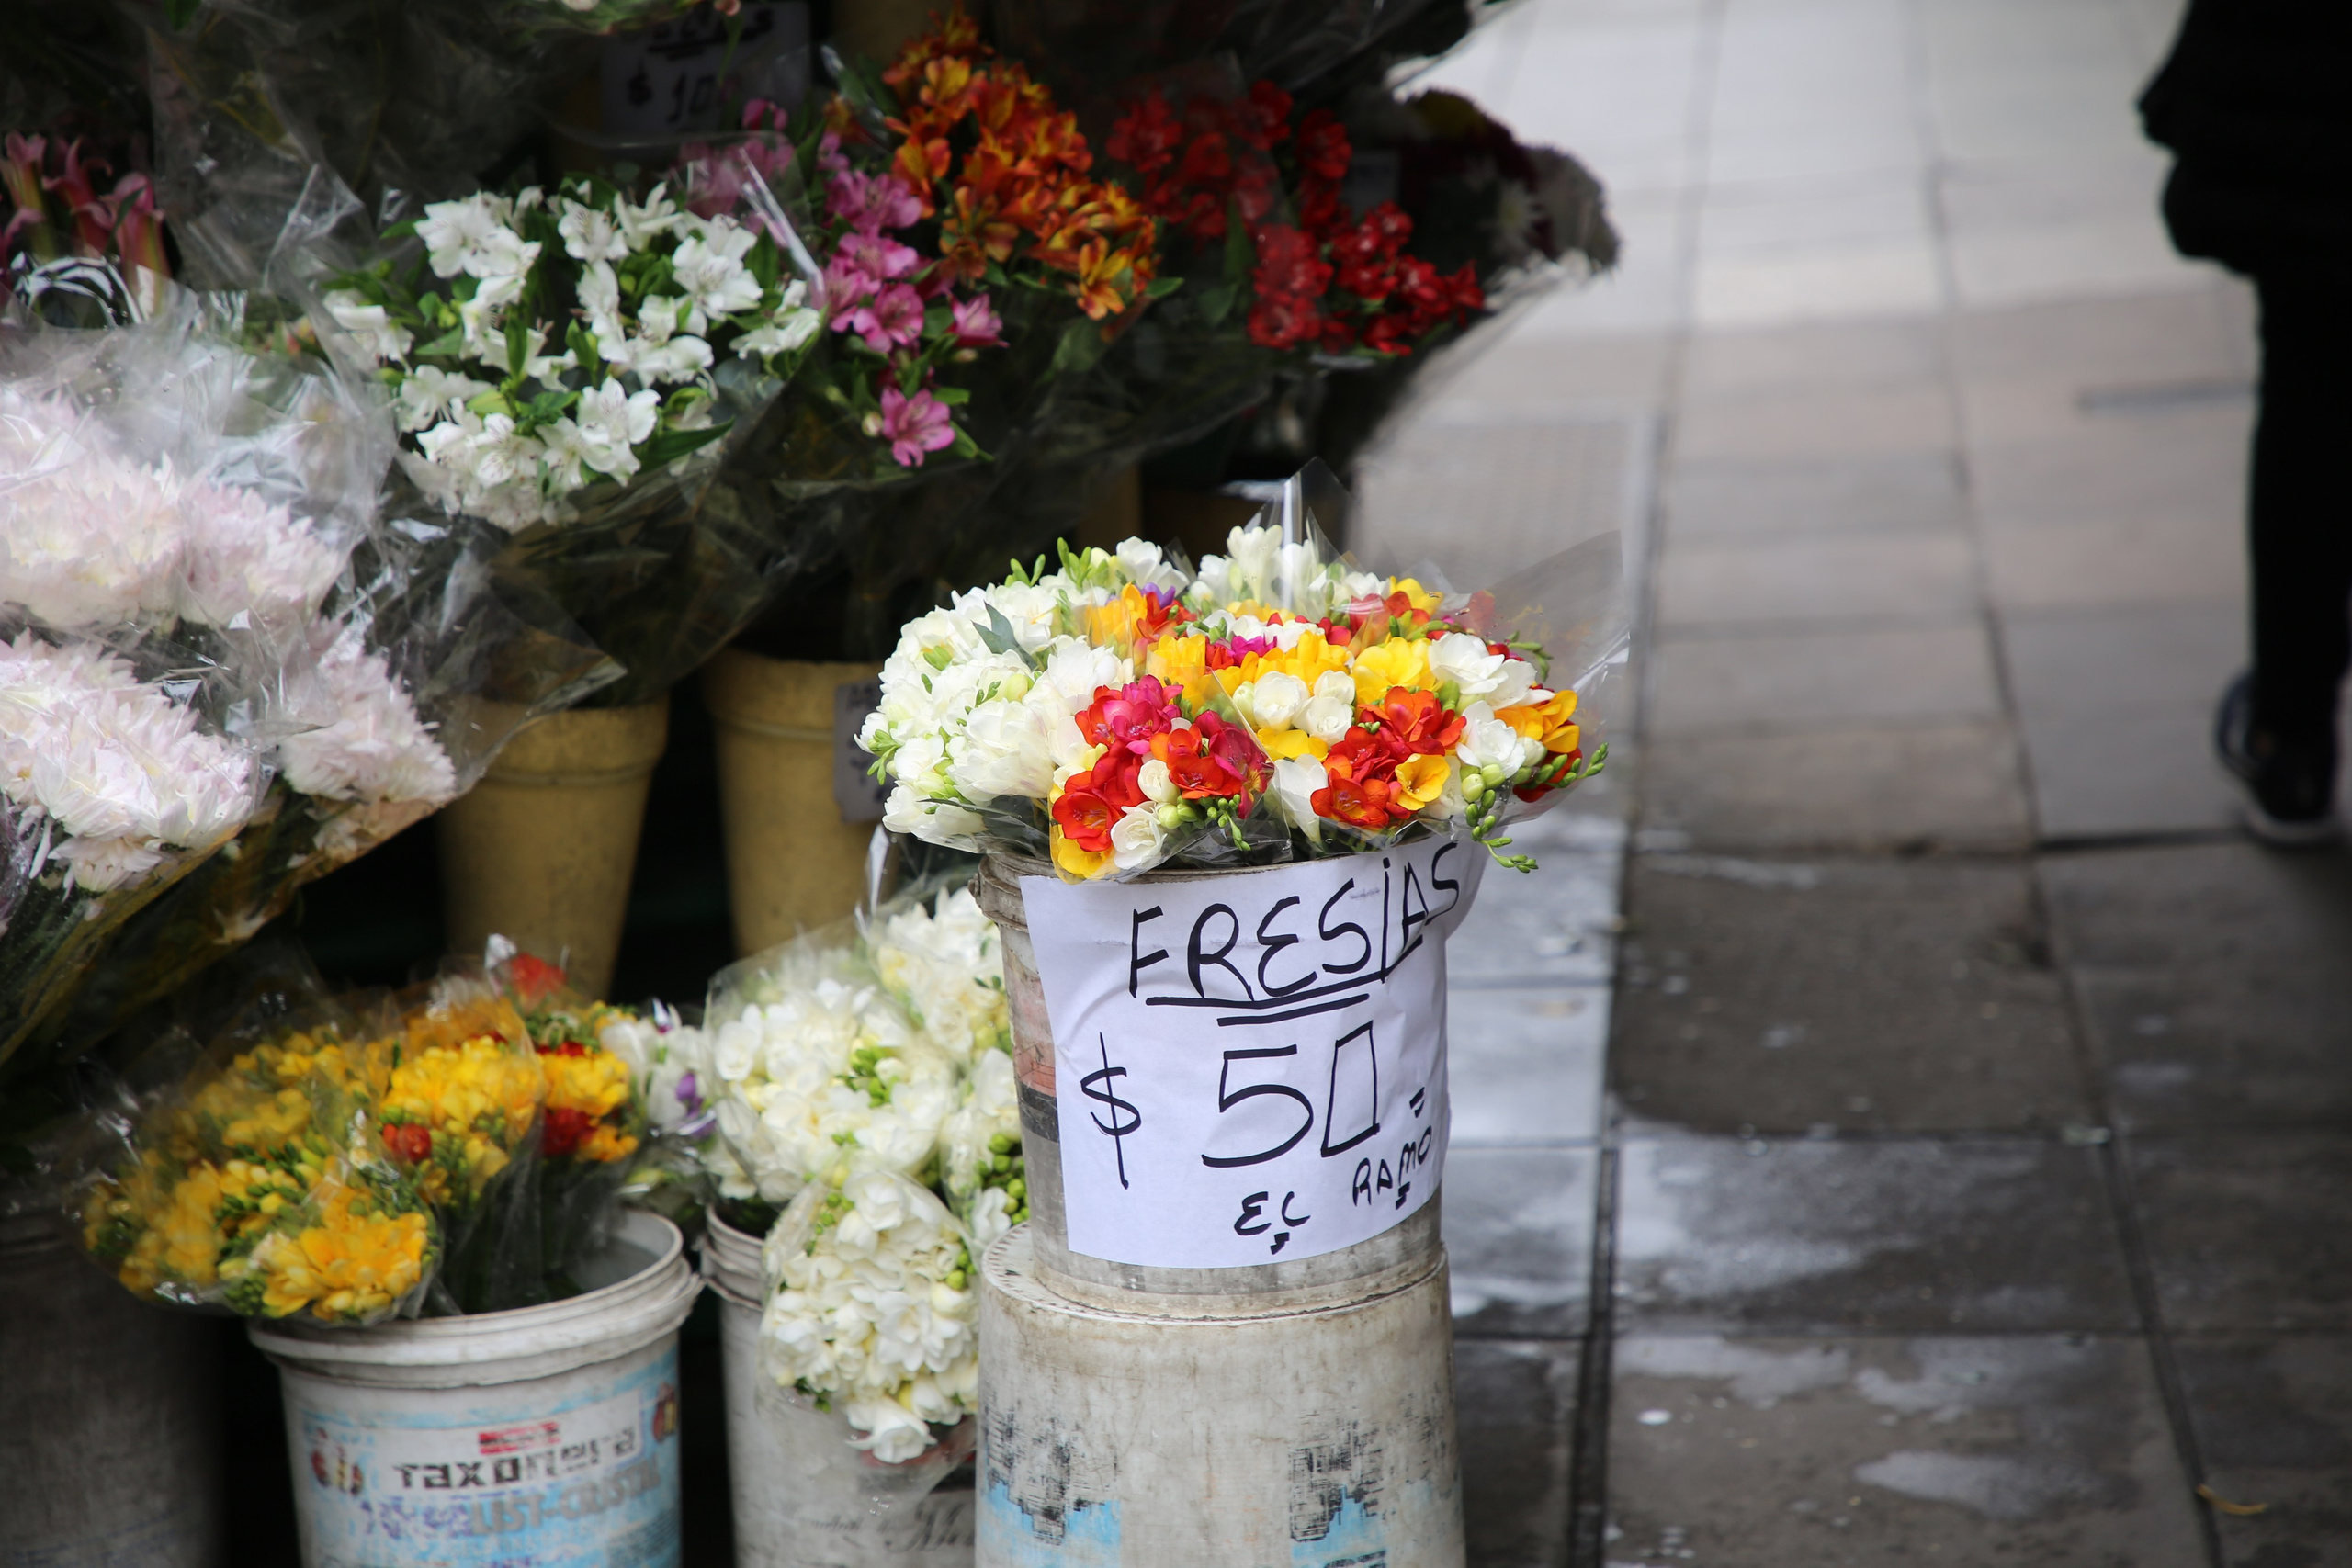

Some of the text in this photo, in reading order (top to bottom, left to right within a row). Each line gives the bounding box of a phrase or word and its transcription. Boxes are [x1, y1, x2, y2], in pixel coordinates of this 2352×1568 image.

[1129, 840, 1459, 1002] FRESIAS
[1080, 1020, 1380, 1190] $ 50
[1352, 1125, 1432, 1207] RAMO
